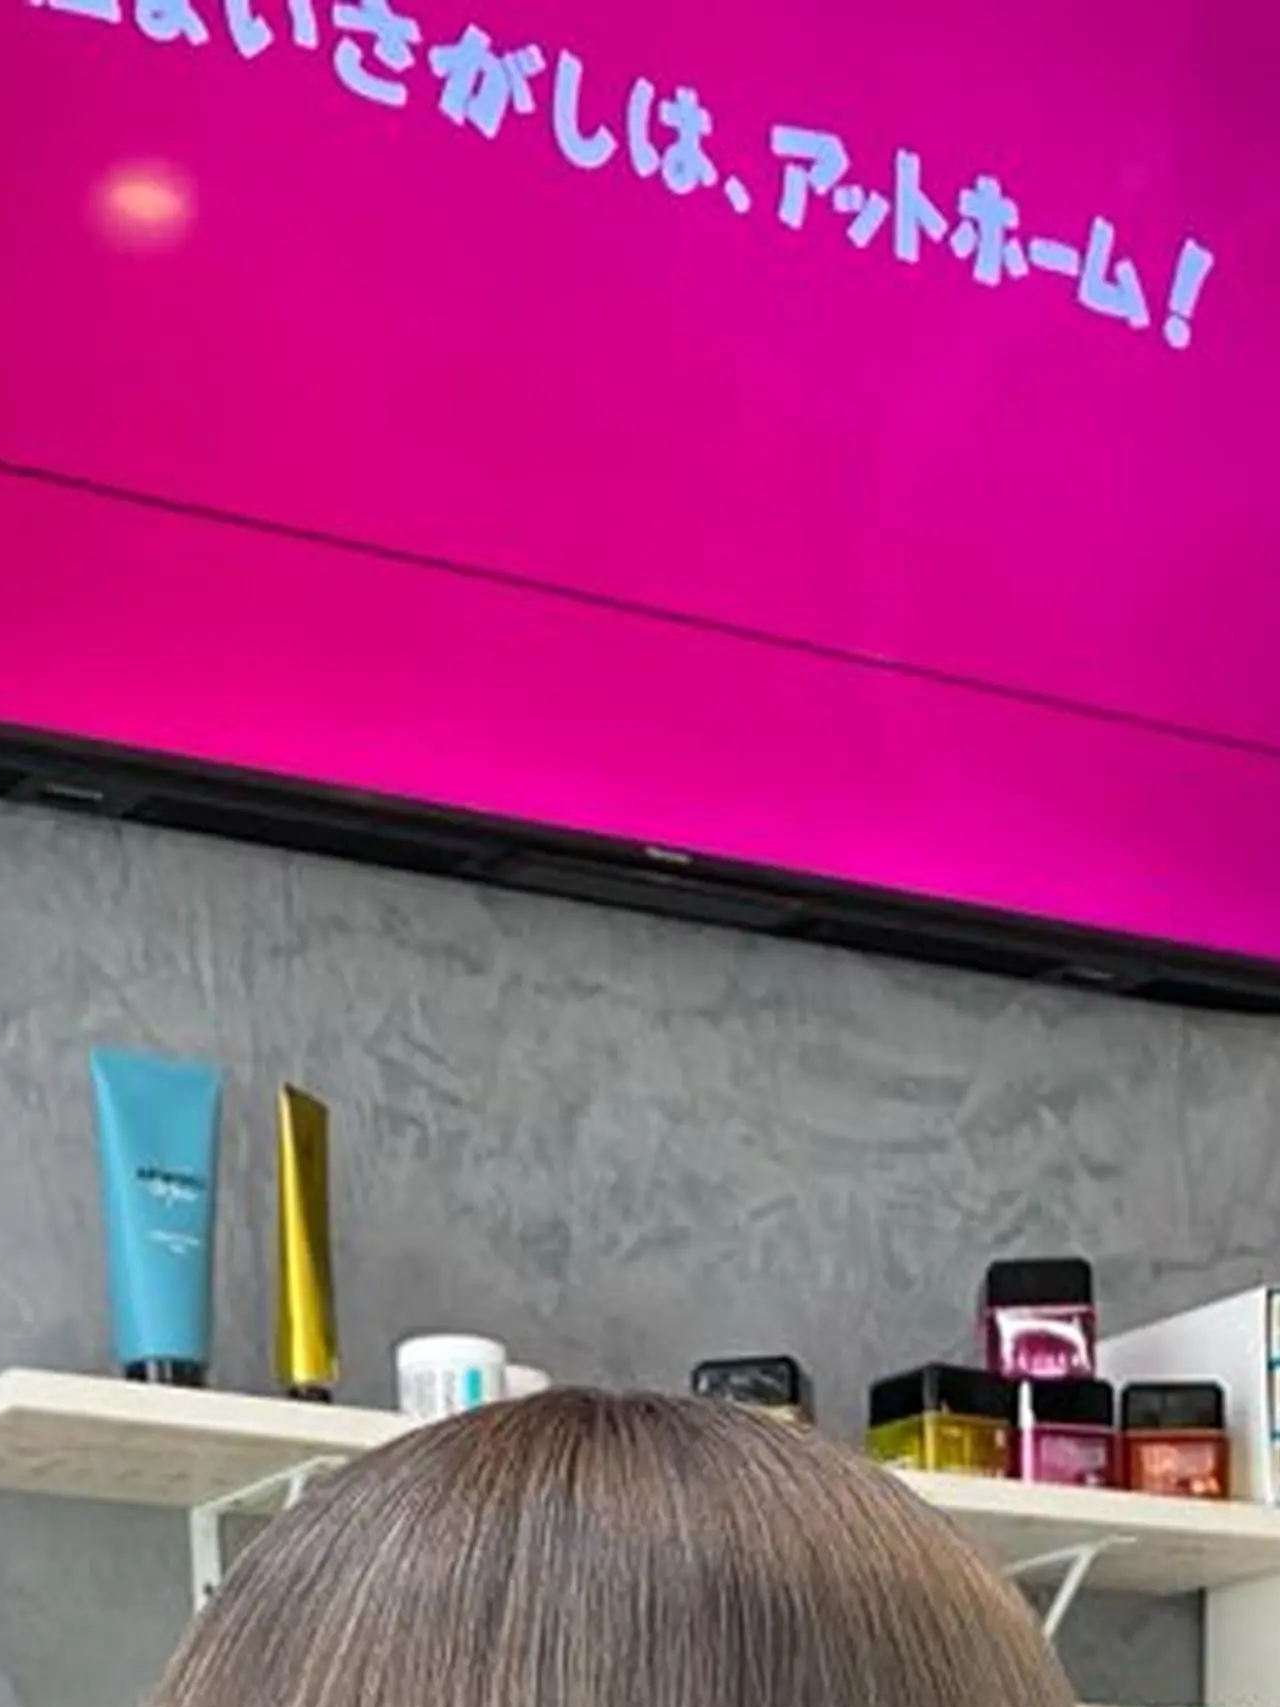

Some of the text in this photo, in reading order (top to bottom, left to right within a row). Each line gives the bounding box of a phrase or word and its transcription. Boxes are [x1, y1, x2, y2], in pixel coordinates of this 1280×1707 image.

[32, 0, 1214, 349] いさがしは、アットホーム！
